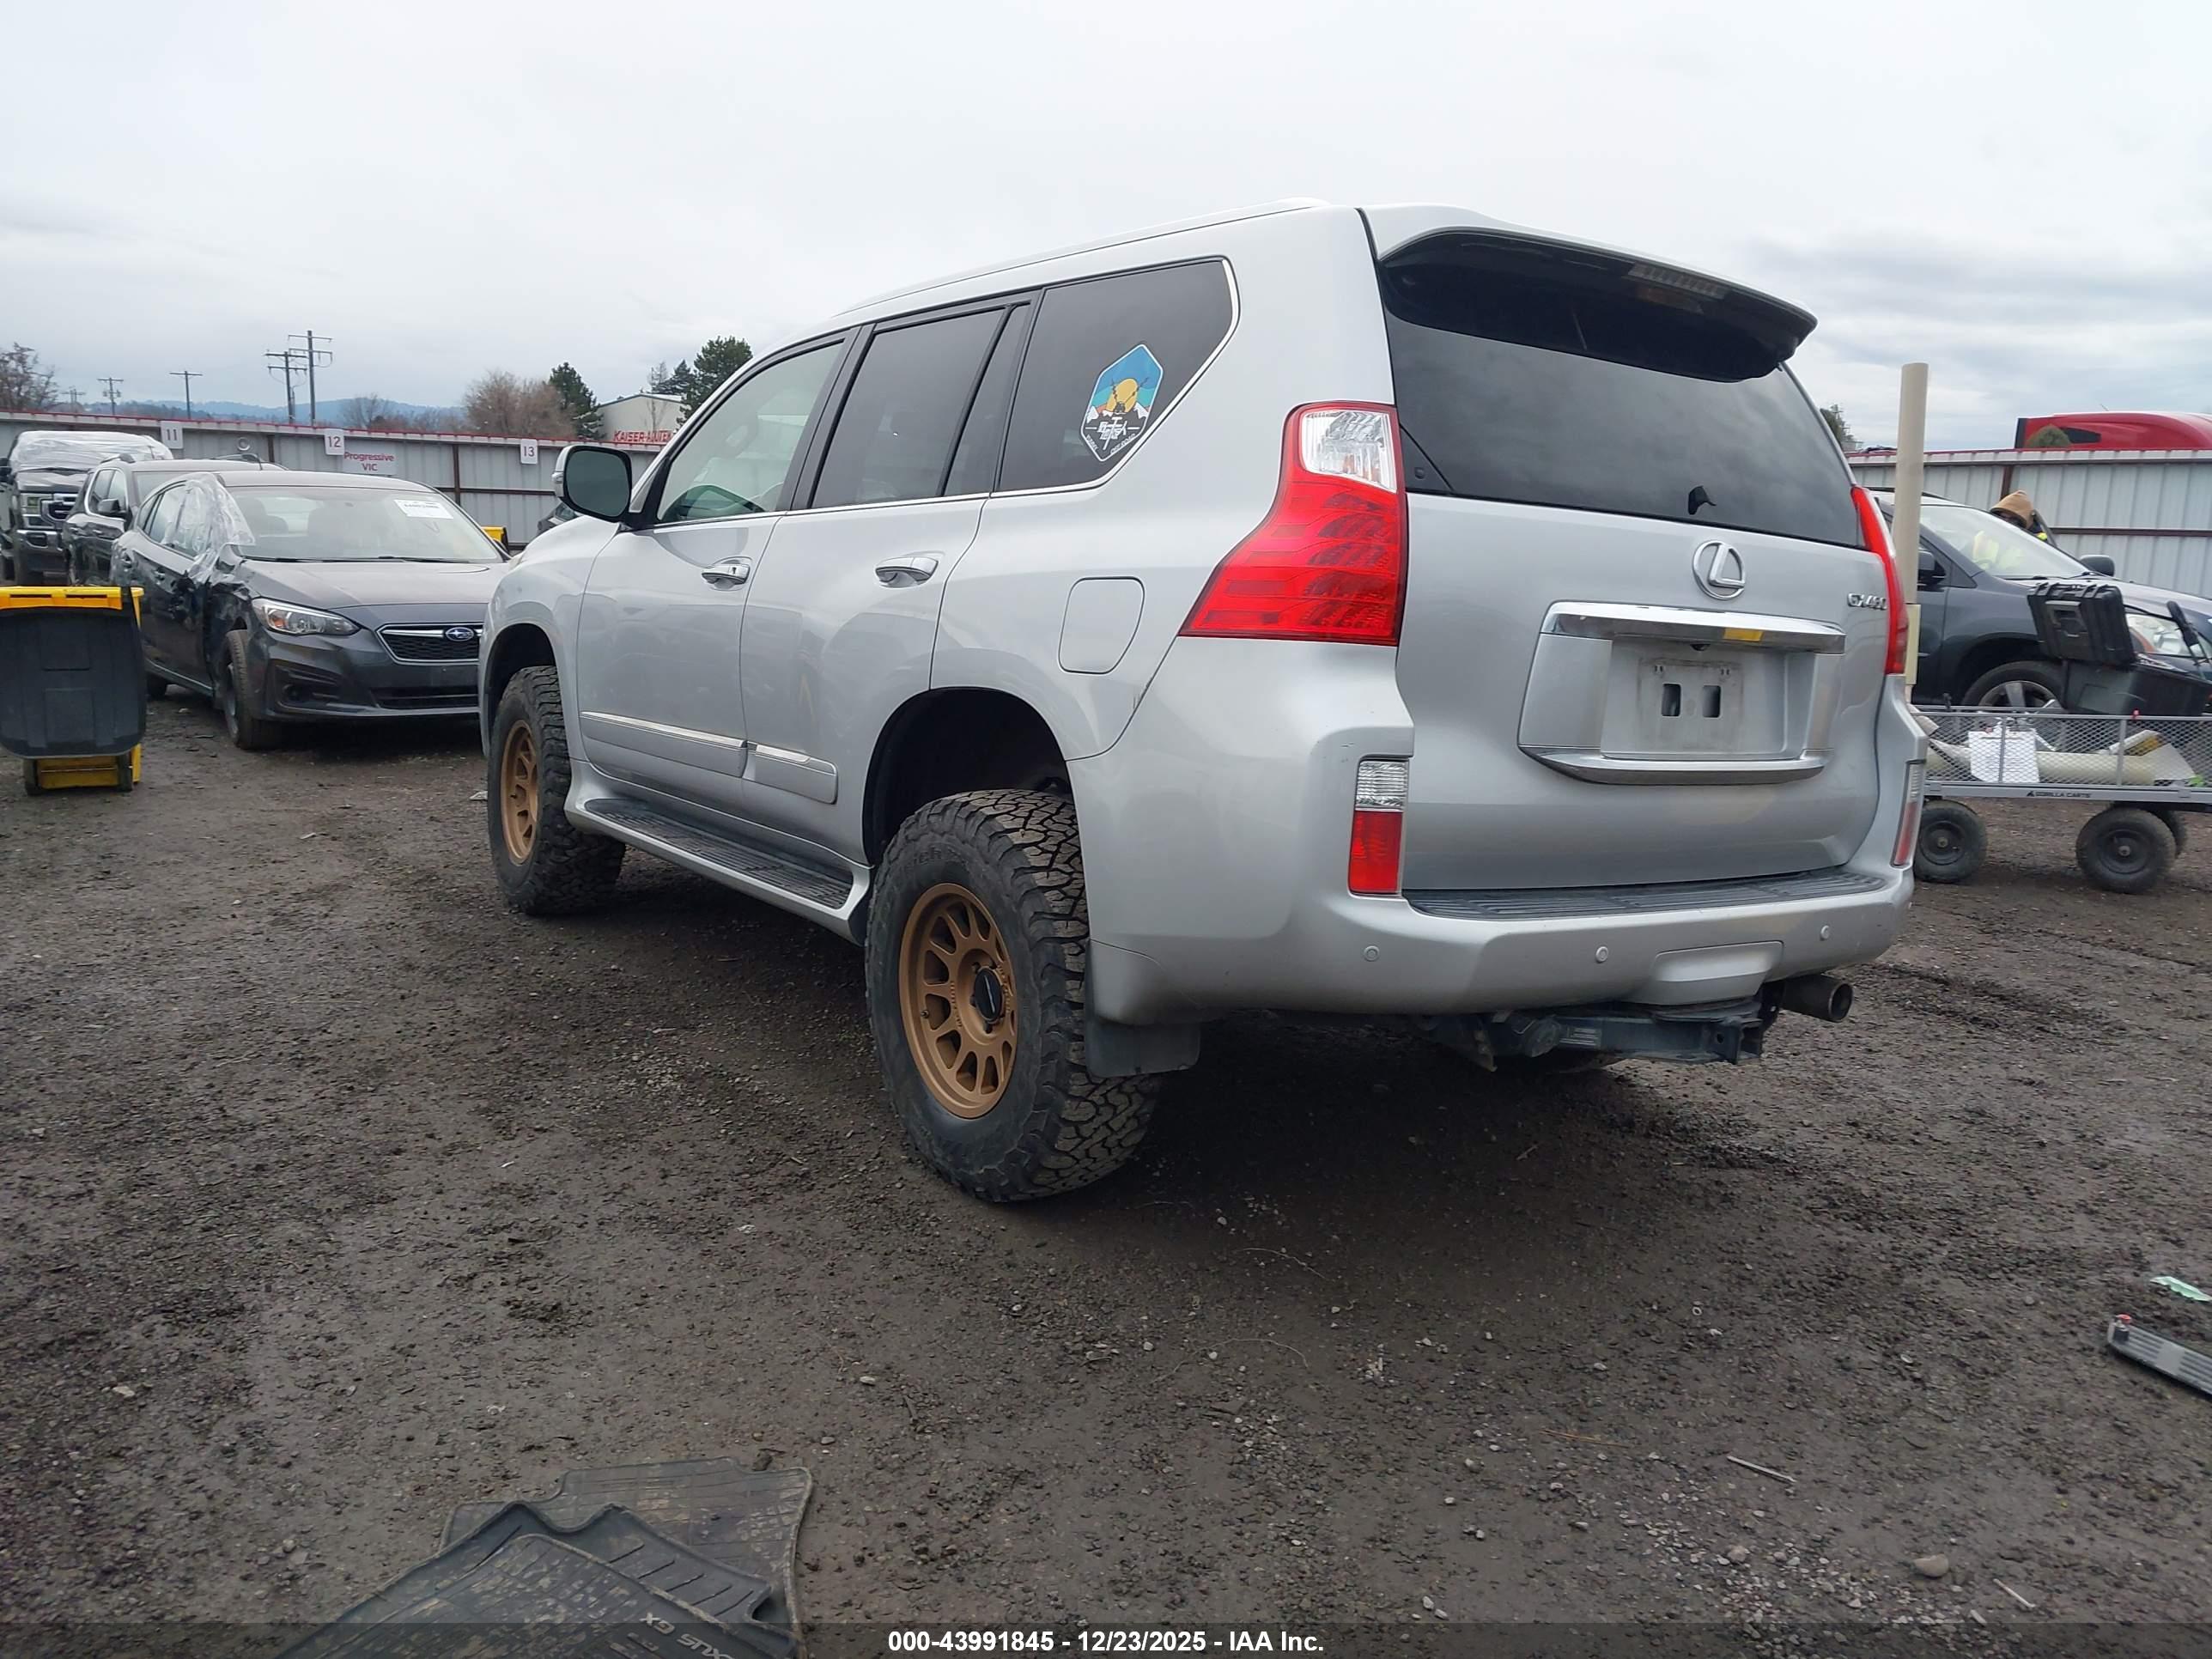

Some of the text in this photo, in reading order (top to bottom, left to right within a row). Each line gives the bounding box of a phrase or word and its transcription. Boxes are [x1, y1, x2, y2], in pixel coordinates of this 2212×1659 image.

[166, 428, 178, 441] 11
[328, 435, 341, 447] 12
[343, 452, 395, 461] Progressive
[524, 446, 535, 457] 13
